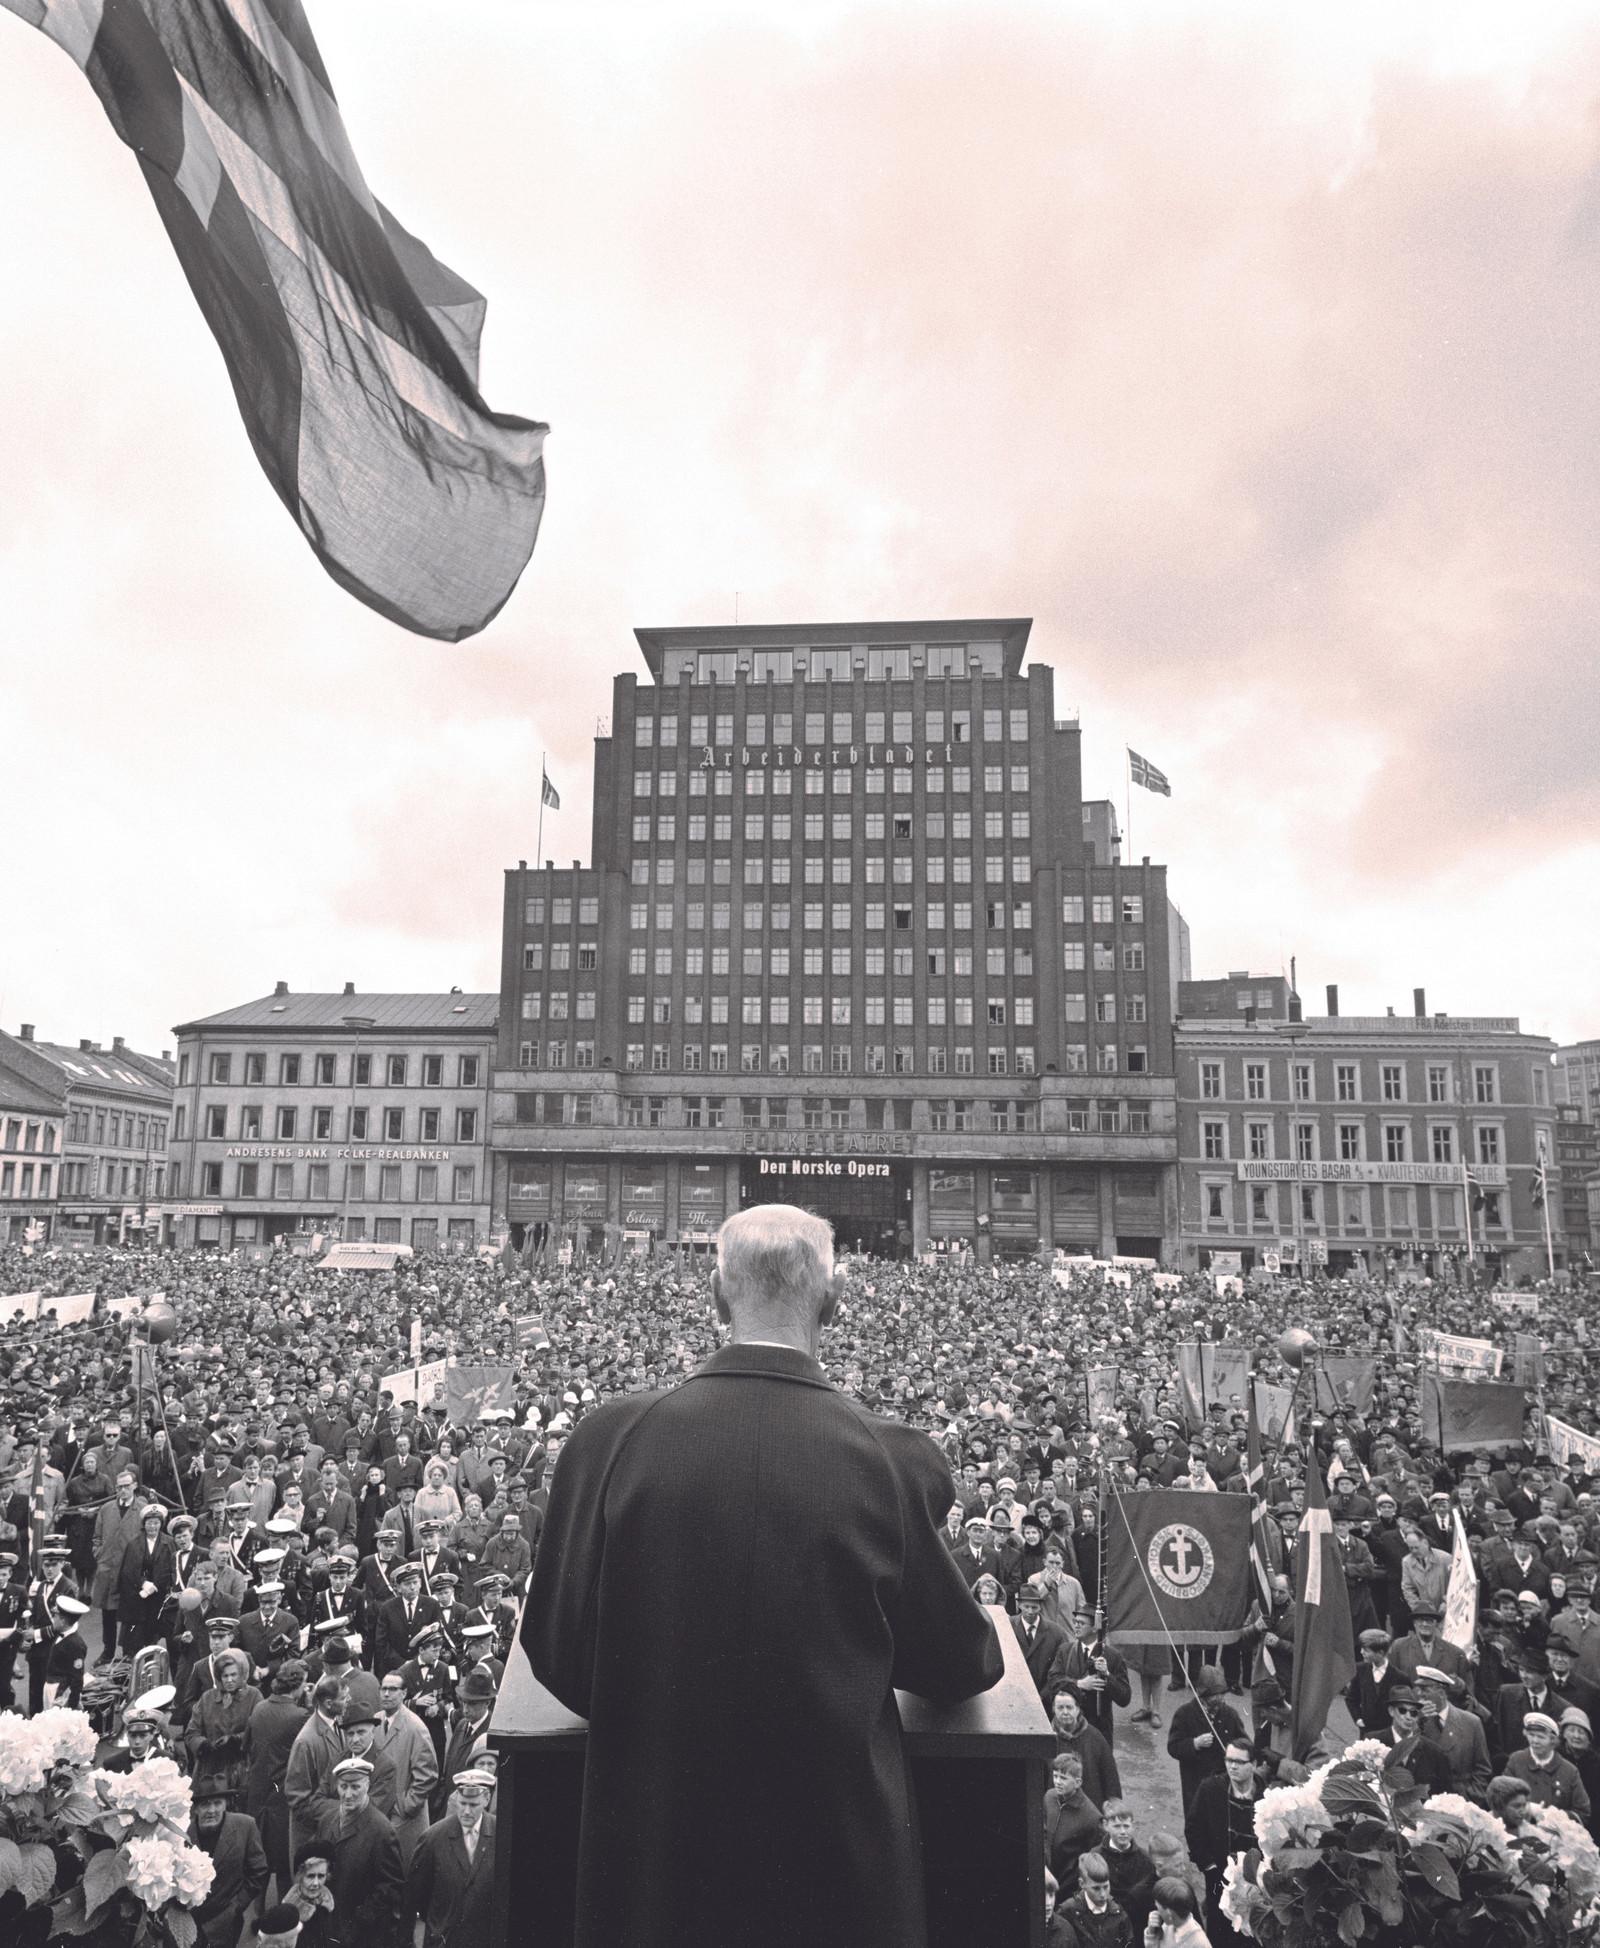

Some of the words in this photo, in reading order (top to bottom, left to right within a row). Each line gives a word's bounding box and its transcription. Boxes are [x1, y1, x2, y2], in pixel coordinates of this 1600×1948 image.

[700, 743, 953, 769] Arbeiderbladet
[1415, 1018, 1433, 1031] FRA
[1434, 1018, 1471, 1031] Adelsten
[1473, 1018, 1516, 1031] BUTIKKENE
[743, 1132, 918, 1152] FOLKETEATRET
[227, 1148, 291, 1158] ANDRESENS
[298, 1149, 327, 1158] BANK
[760, 1159, 786, 1174] Den
[792, 1160, 842, 1175] Norske
[848, 1160, 890, 1177] Opera
[1321, 1163, 1352, 1180] BASAR
[626, 1209, 658, 1225] Erling
[1400, 1241, 1426, 1251] Oslo
